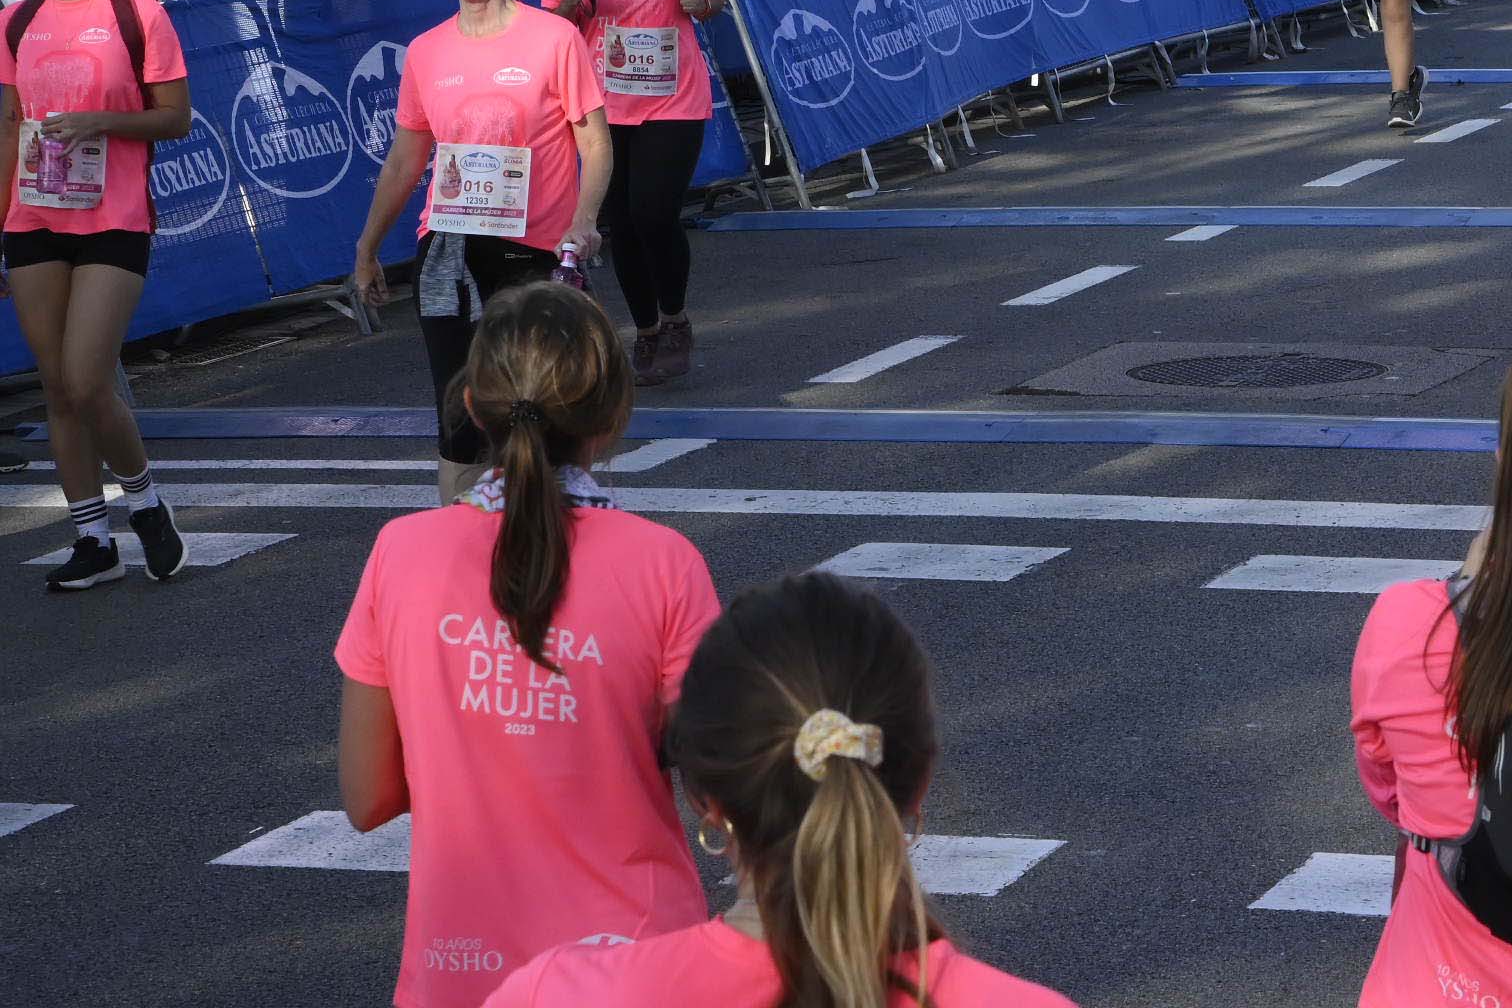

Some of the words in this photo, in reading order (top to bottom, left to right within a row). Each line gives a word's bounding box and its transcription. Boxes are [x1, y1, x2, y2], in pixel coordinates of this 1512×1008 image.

[628, 54, 655, 65] 016
[243, 117, 348, 170] ASTURIANA
[463, 159, 497, 169] ASTURIANA
[464, 180, 494, 194] 016
[465, 196, 489, 205] 12393
[468, 649, 514, 684] DE
[460, 682, 578, 723] MUJER
[504, 722, 536, 736] 2023
[424, 947, 504, 972] OYSHO
